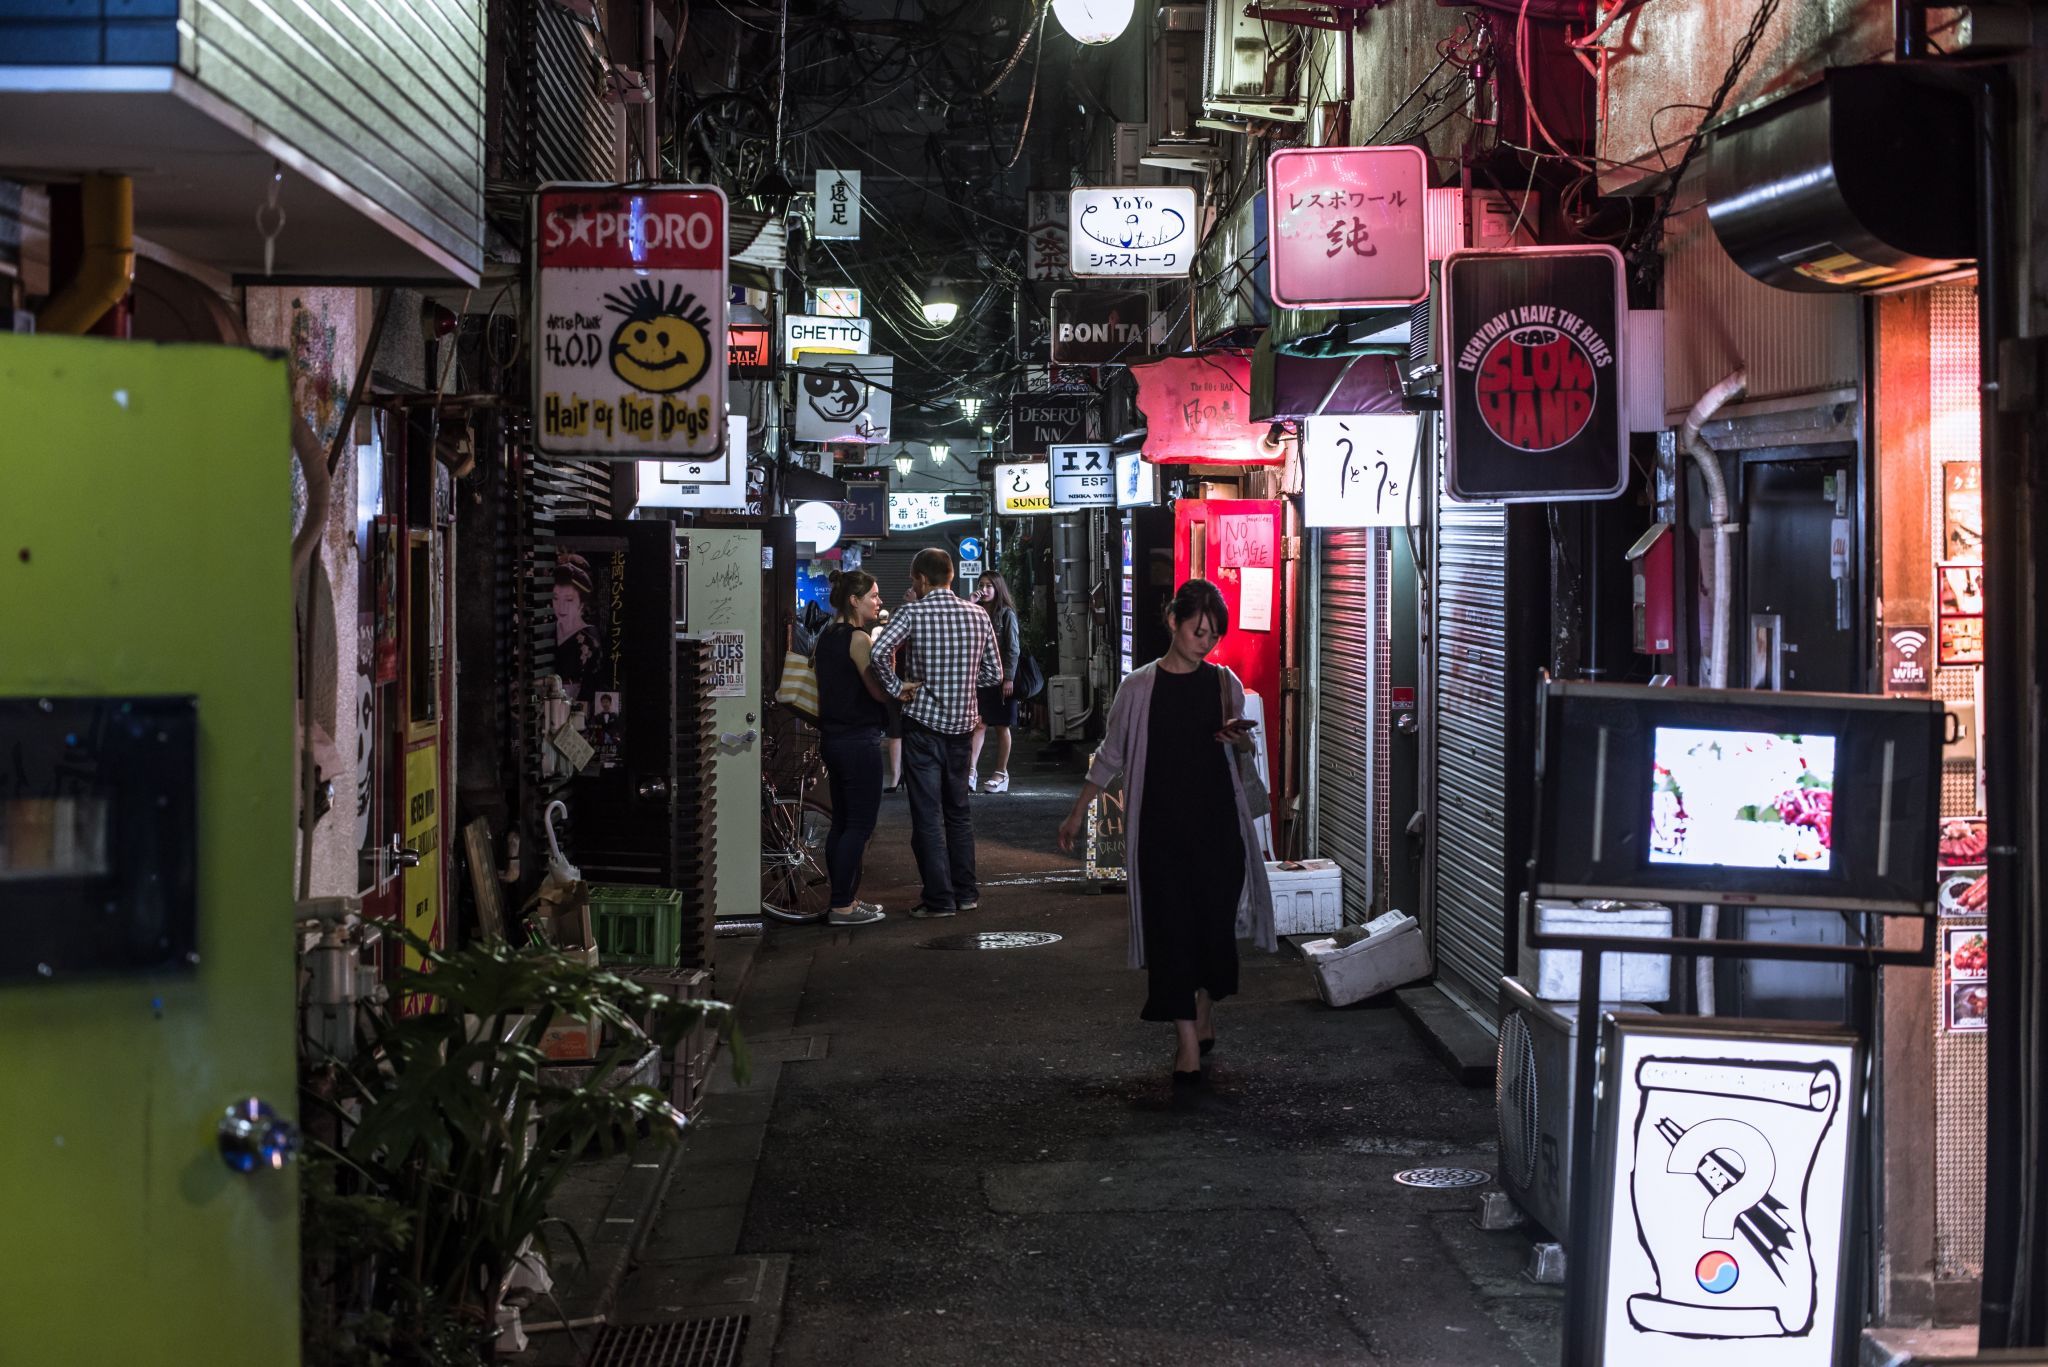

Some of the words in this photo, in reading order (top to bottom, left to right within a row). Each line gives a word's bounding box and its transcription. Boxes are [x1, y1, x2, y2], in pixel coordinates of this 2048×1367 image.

[829, 179, 849, 226] 遠足
[1289, 190, 1407, 211] レスポワール
[1326, 216, 1378, 259] 純
[1090, 253, 1176, 268] シネストーク
[791, 325, 861, 341] GHETTO
[1457, 311, 1511, 373] EVERYDAY
[1510, 309, 1519, 326] I
[1519, 305, 1555, 324] HAVE
[1558, 309, 1582, 335] THE
[1578, 327, 1614, 369] BLUES
[1513, 329, 1558, 345] BAR
[1479, 334, 1594, 391] SLOW
[545, 396, 590, 434] Hair
[595, 405, 613, 437] of
[619, 395, 653, 432] the
[661, 400, 709, 440] Dogs
[1019, 406, 1081, 426] DESERT
[1480, 391, 1592, 450] HAND
[1033, 426, 1062, 442] INN
[1081, 477, 1109, 487] ESP
[1225, 521, 1248, 542] NO
[1226, 540, 1269, 562] CHAGE
[710, 645, 744, 660] LUES
[1892, 667, 1924, 679] WiFi
[1102, 788, 1124, 816] N
[1096, 816, 1123, 837] CH
[1098, 840, 1126, 855] DRIN
